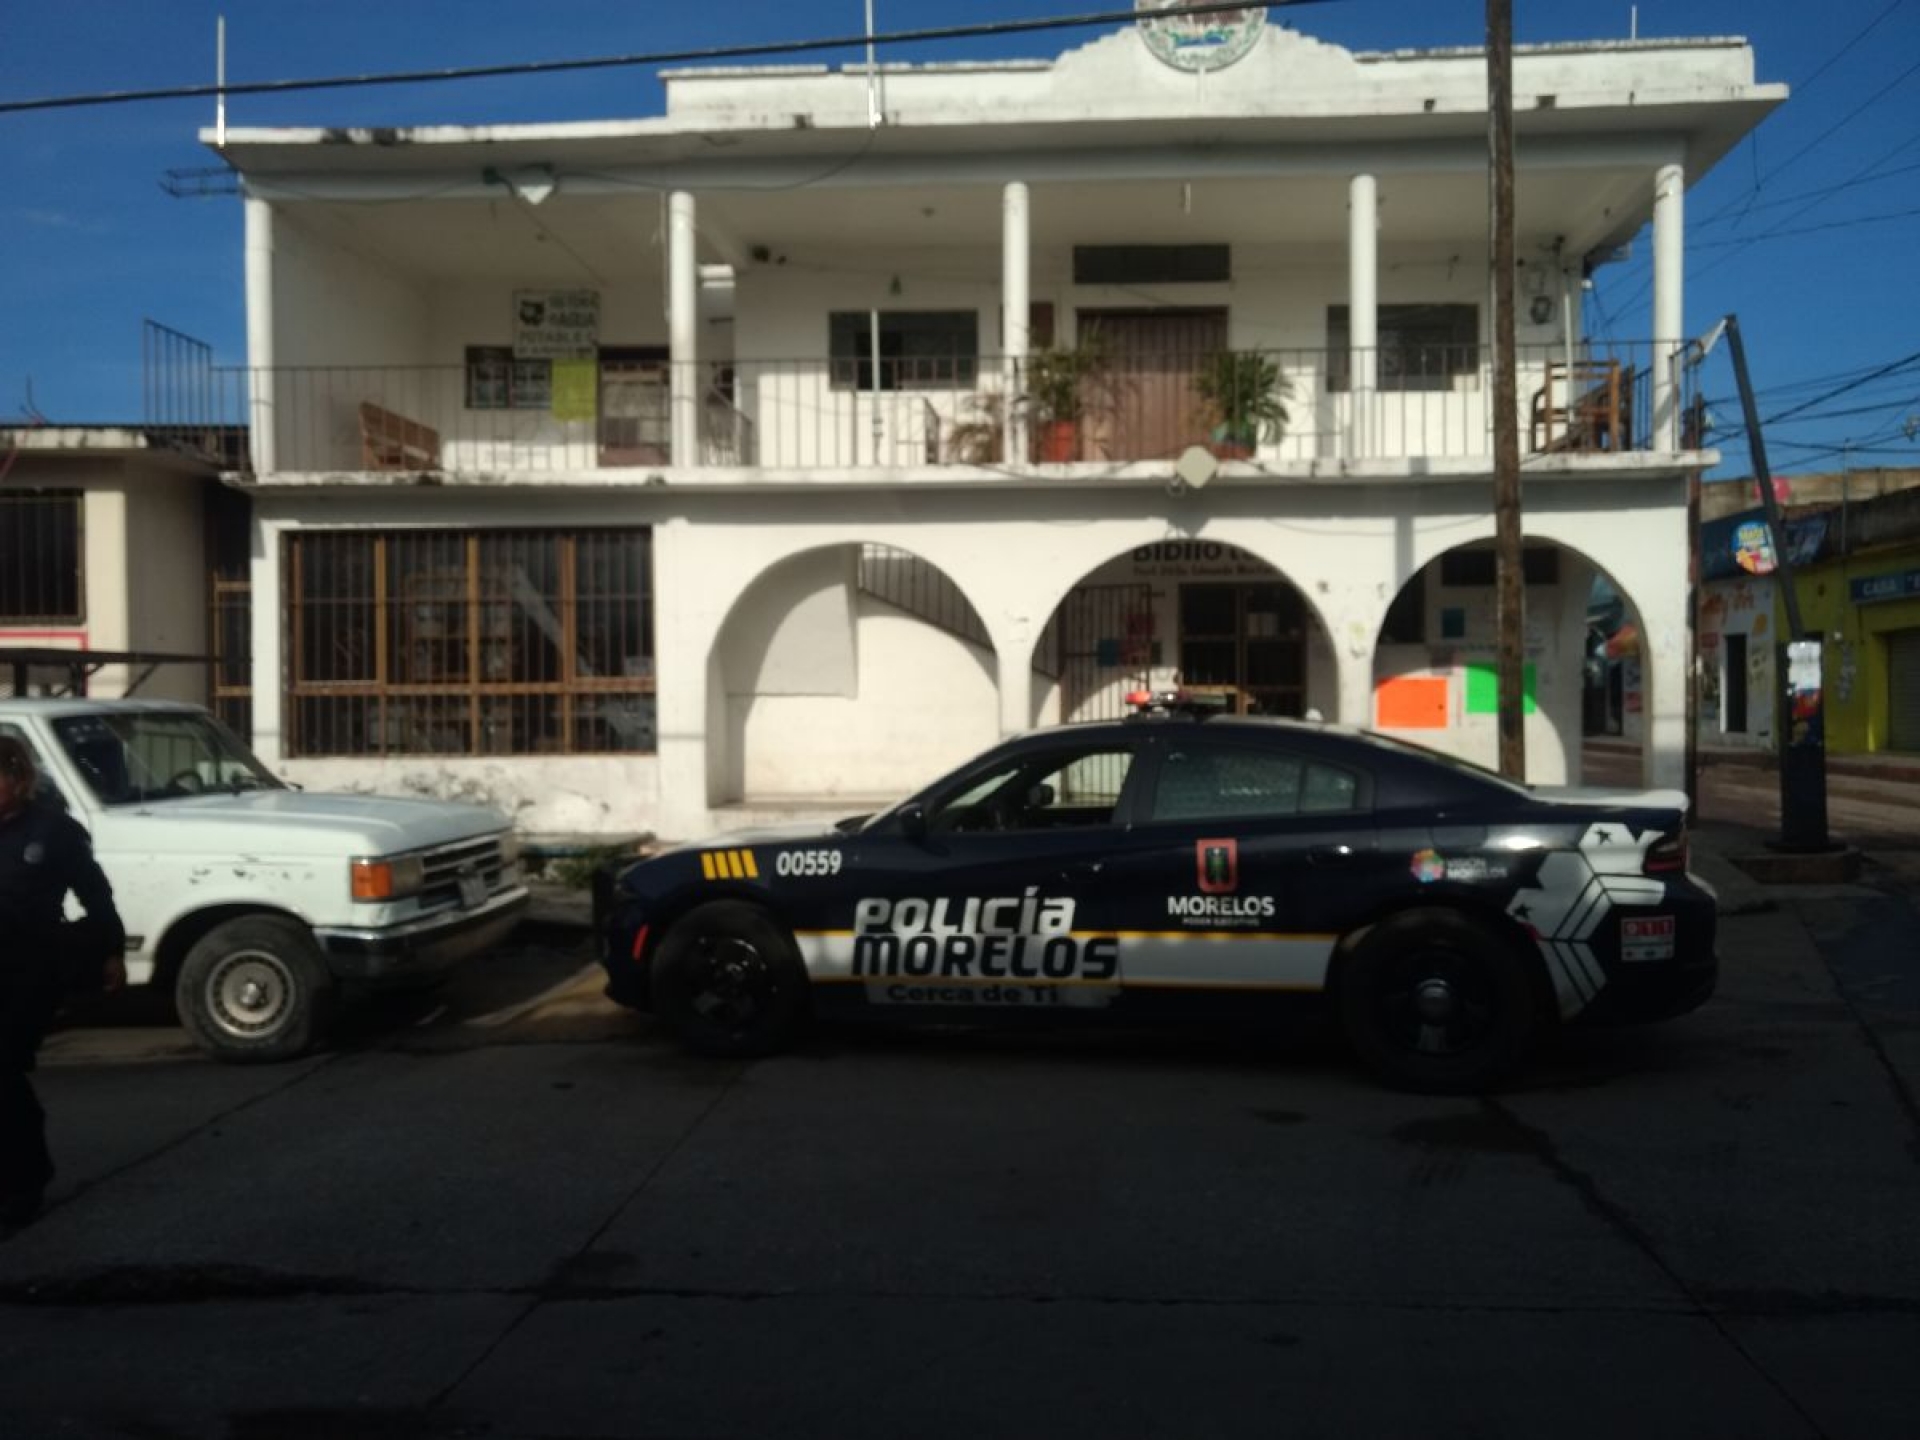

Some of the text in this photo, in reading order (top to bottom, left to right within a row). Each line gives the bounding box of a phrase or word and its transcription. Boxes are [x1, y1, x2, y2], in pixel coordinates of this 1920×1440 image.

[776, 850, 842, 877] 00559
[1167, 895, 1275, 916] MORELOS
[852, 935, 1119, 979] MORELOS
[886, 983, 974, 1001] Cerca
[982, 982, 1021, 1002] de
